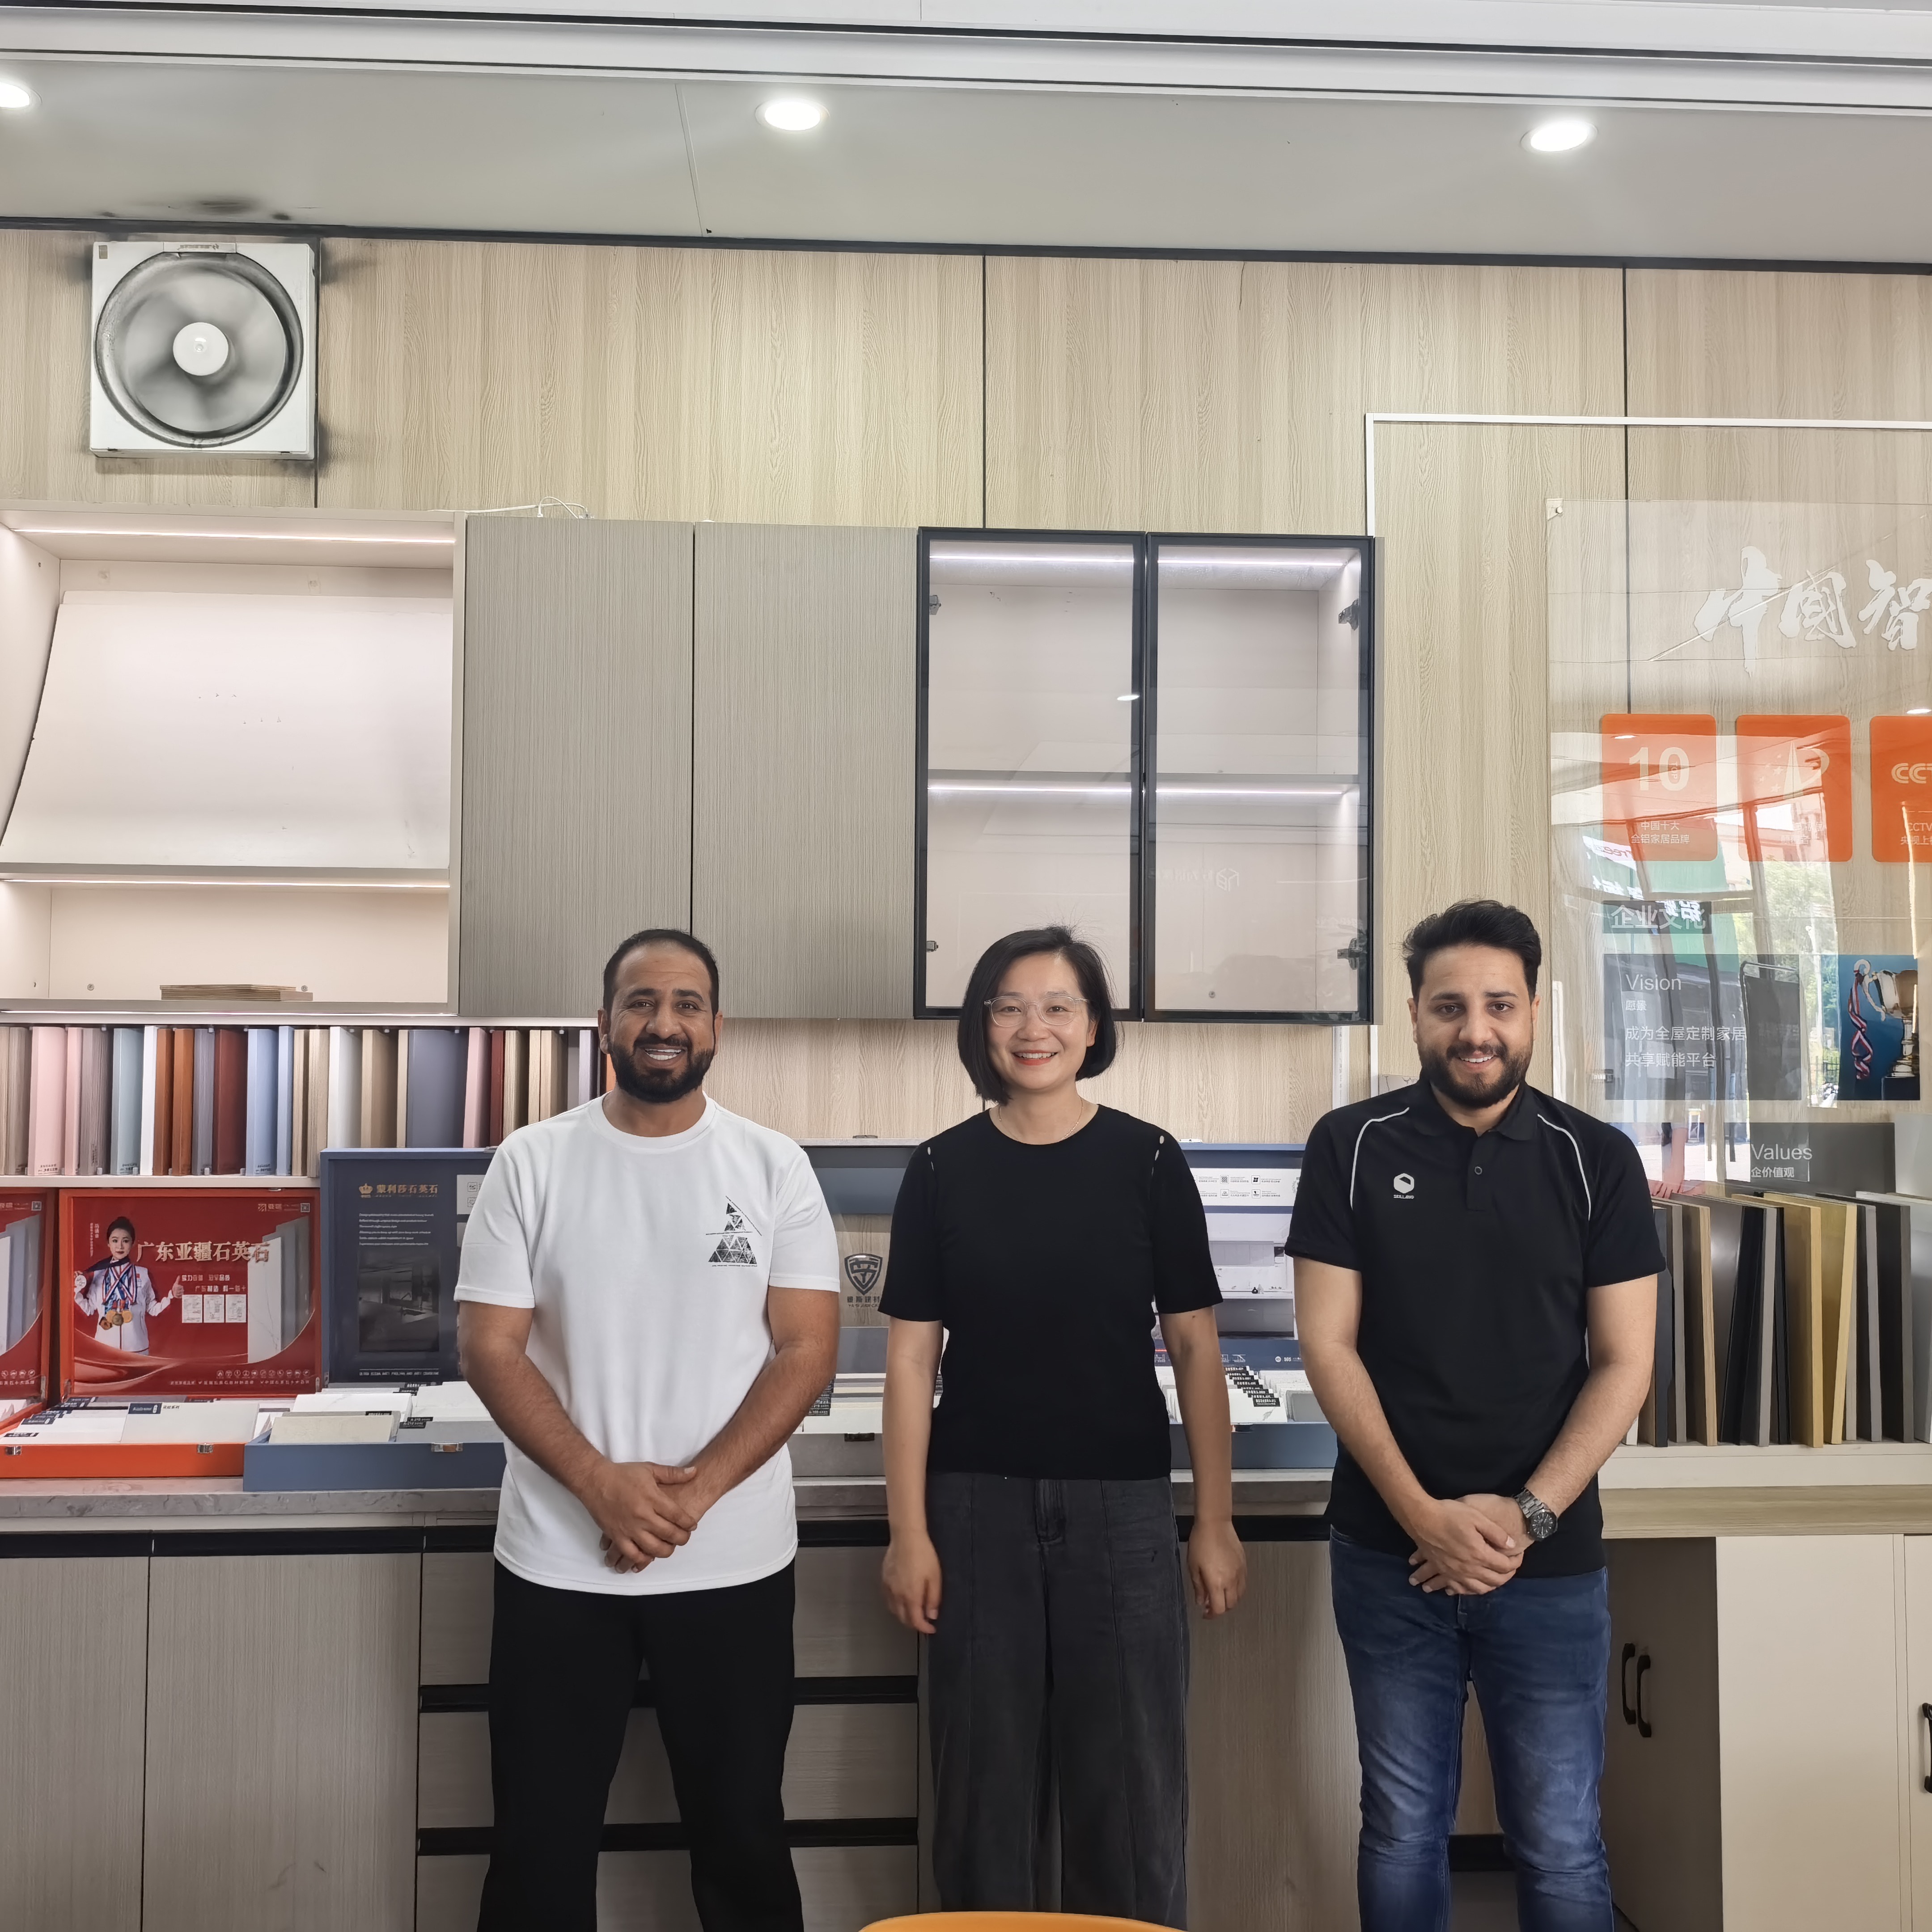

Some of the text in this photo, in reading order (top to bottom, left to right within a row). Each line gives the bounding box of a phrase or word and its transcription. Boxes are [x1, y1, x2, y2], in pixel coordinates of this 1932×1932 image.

[1629, 747, 1689, 791] 10
[1669, 761, 1678, 779] TOP
[1641, 821, 1680, 830] 中国十大
[1631, 834, 1690, 844] 全铝家居品牌
[1610, 904, 1706, 930] 企业文化
[1626, 974, 1682, 991] Vision
[1626, 1000, 1647, 1011] 愿景
[1625, 1026, 1746, 1041] 成为全屋定制家居
[1625, 1052, 1716, 1068] 共享赋能平台
[1751, 1144, 1813, 1160] Values
[1751, 1167, 1795, 1178] 企价值观
[136, 1241, 270, 1263] 广东亚疆石英石
